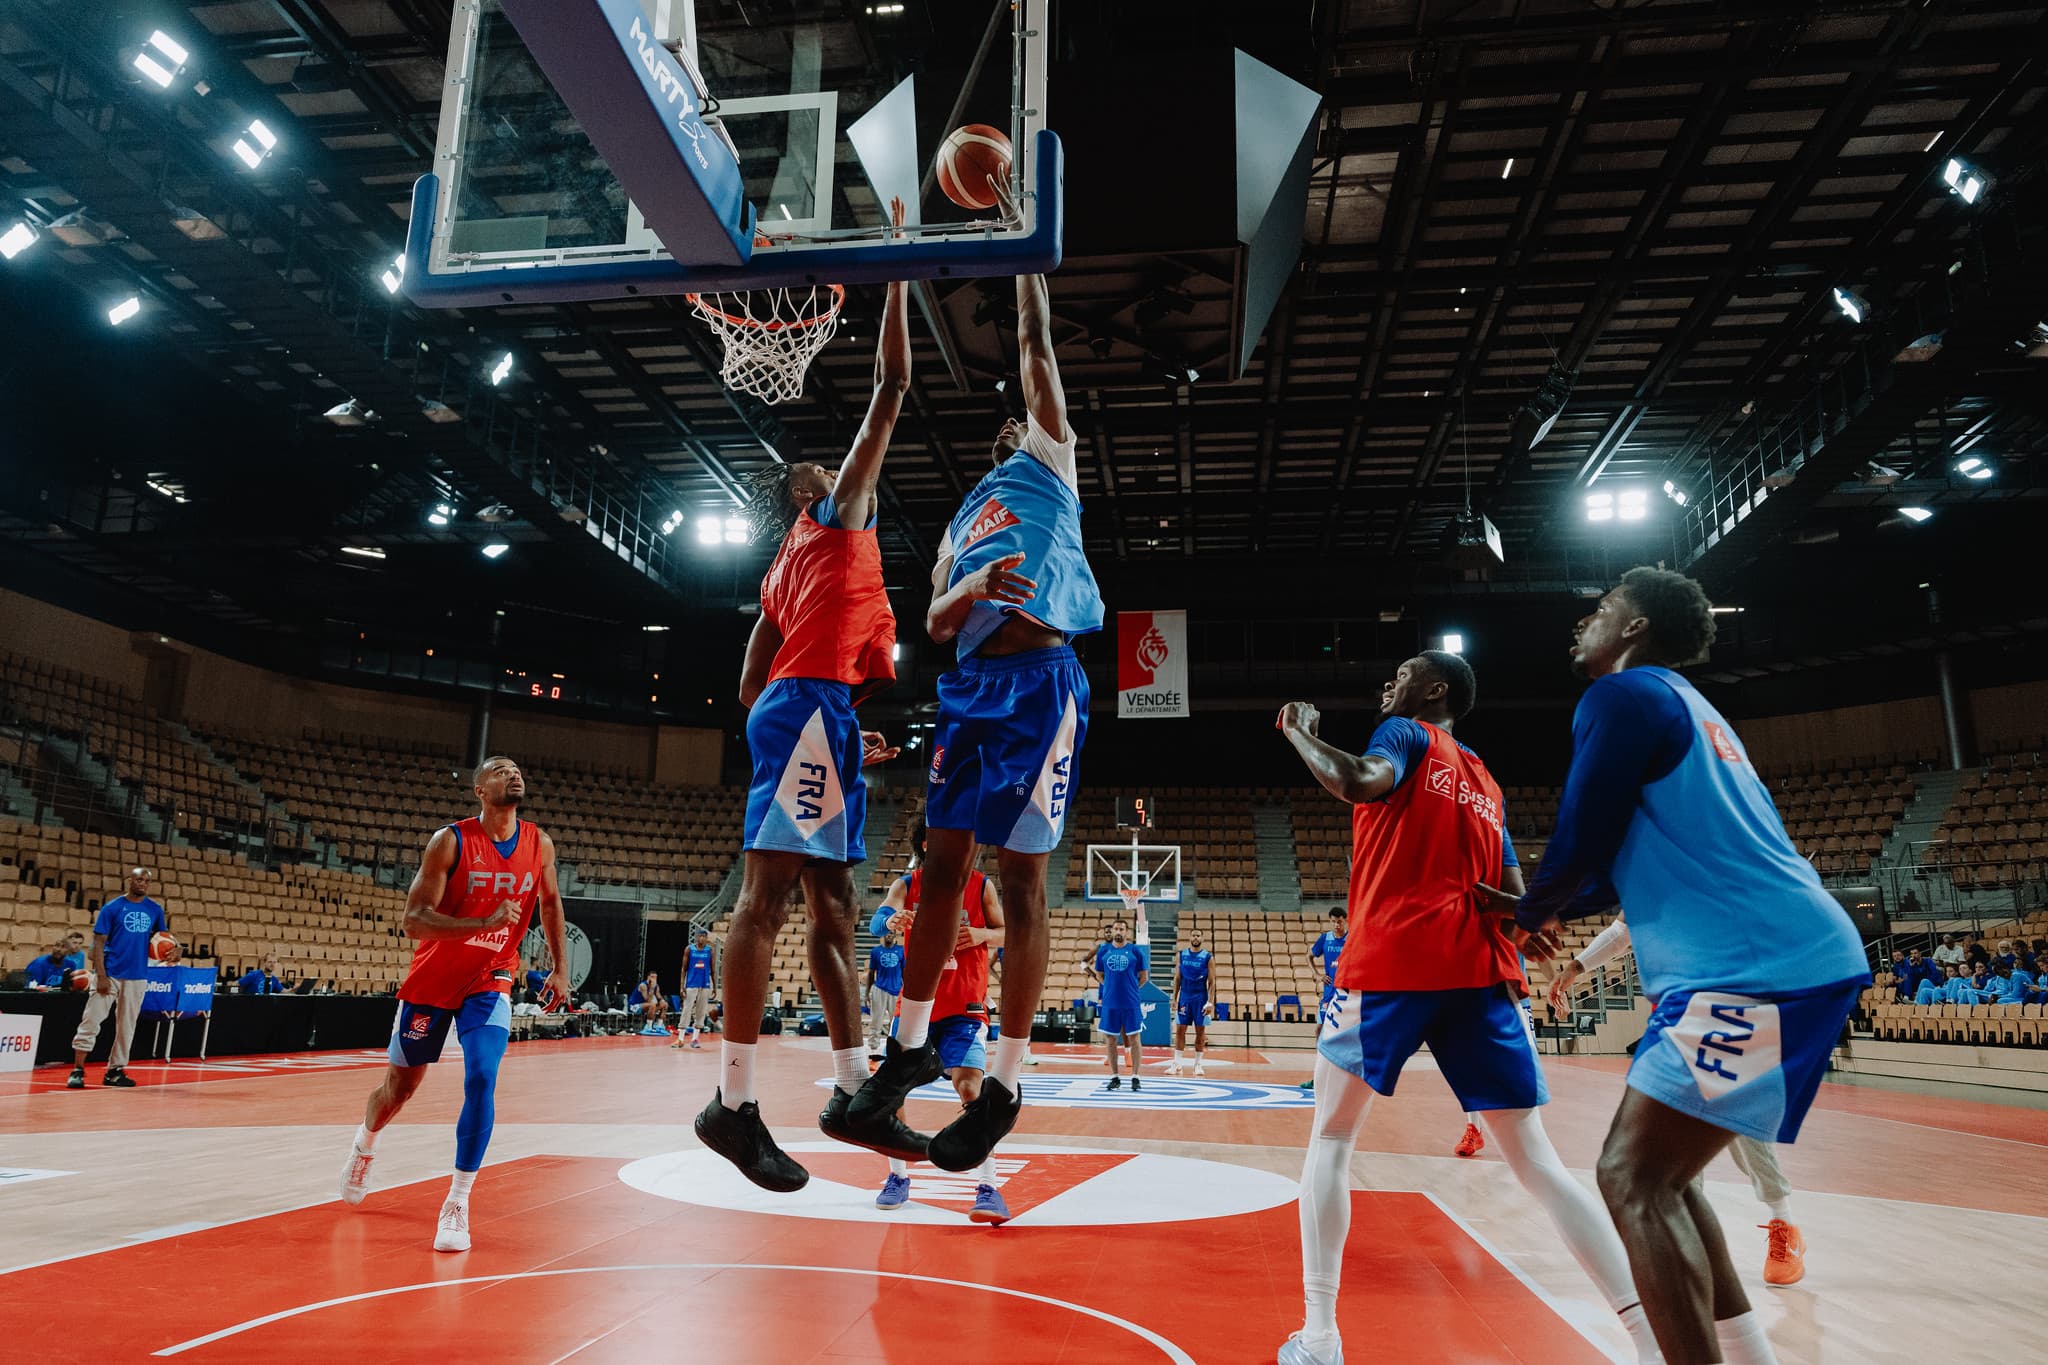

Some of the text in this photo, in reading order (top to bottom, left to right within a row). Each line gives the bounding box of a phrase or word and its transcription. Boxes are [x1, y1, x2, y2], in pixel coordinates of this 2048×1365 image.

[630, 16, 694, 120] MARTY
[967, 506, 1009, 542] MAIF
[1126, 690, 1181, 706] VENDÉE
[1135, 706, 1181, 714] DÉPARTEMENT
[795, 761, 828, 820] FRA
[1050, 754, 1070, 819] FRA
[1459, 780, 1497, 814] CISSE
[1136, 809, 1146, 825] 7
[467, 871, 534, 895] FRA
[473, 932, 509, 945] MAIF
[0, 1035, 32, 1053] FFBB
[1696, 1003, 1758, 1082] FRA
